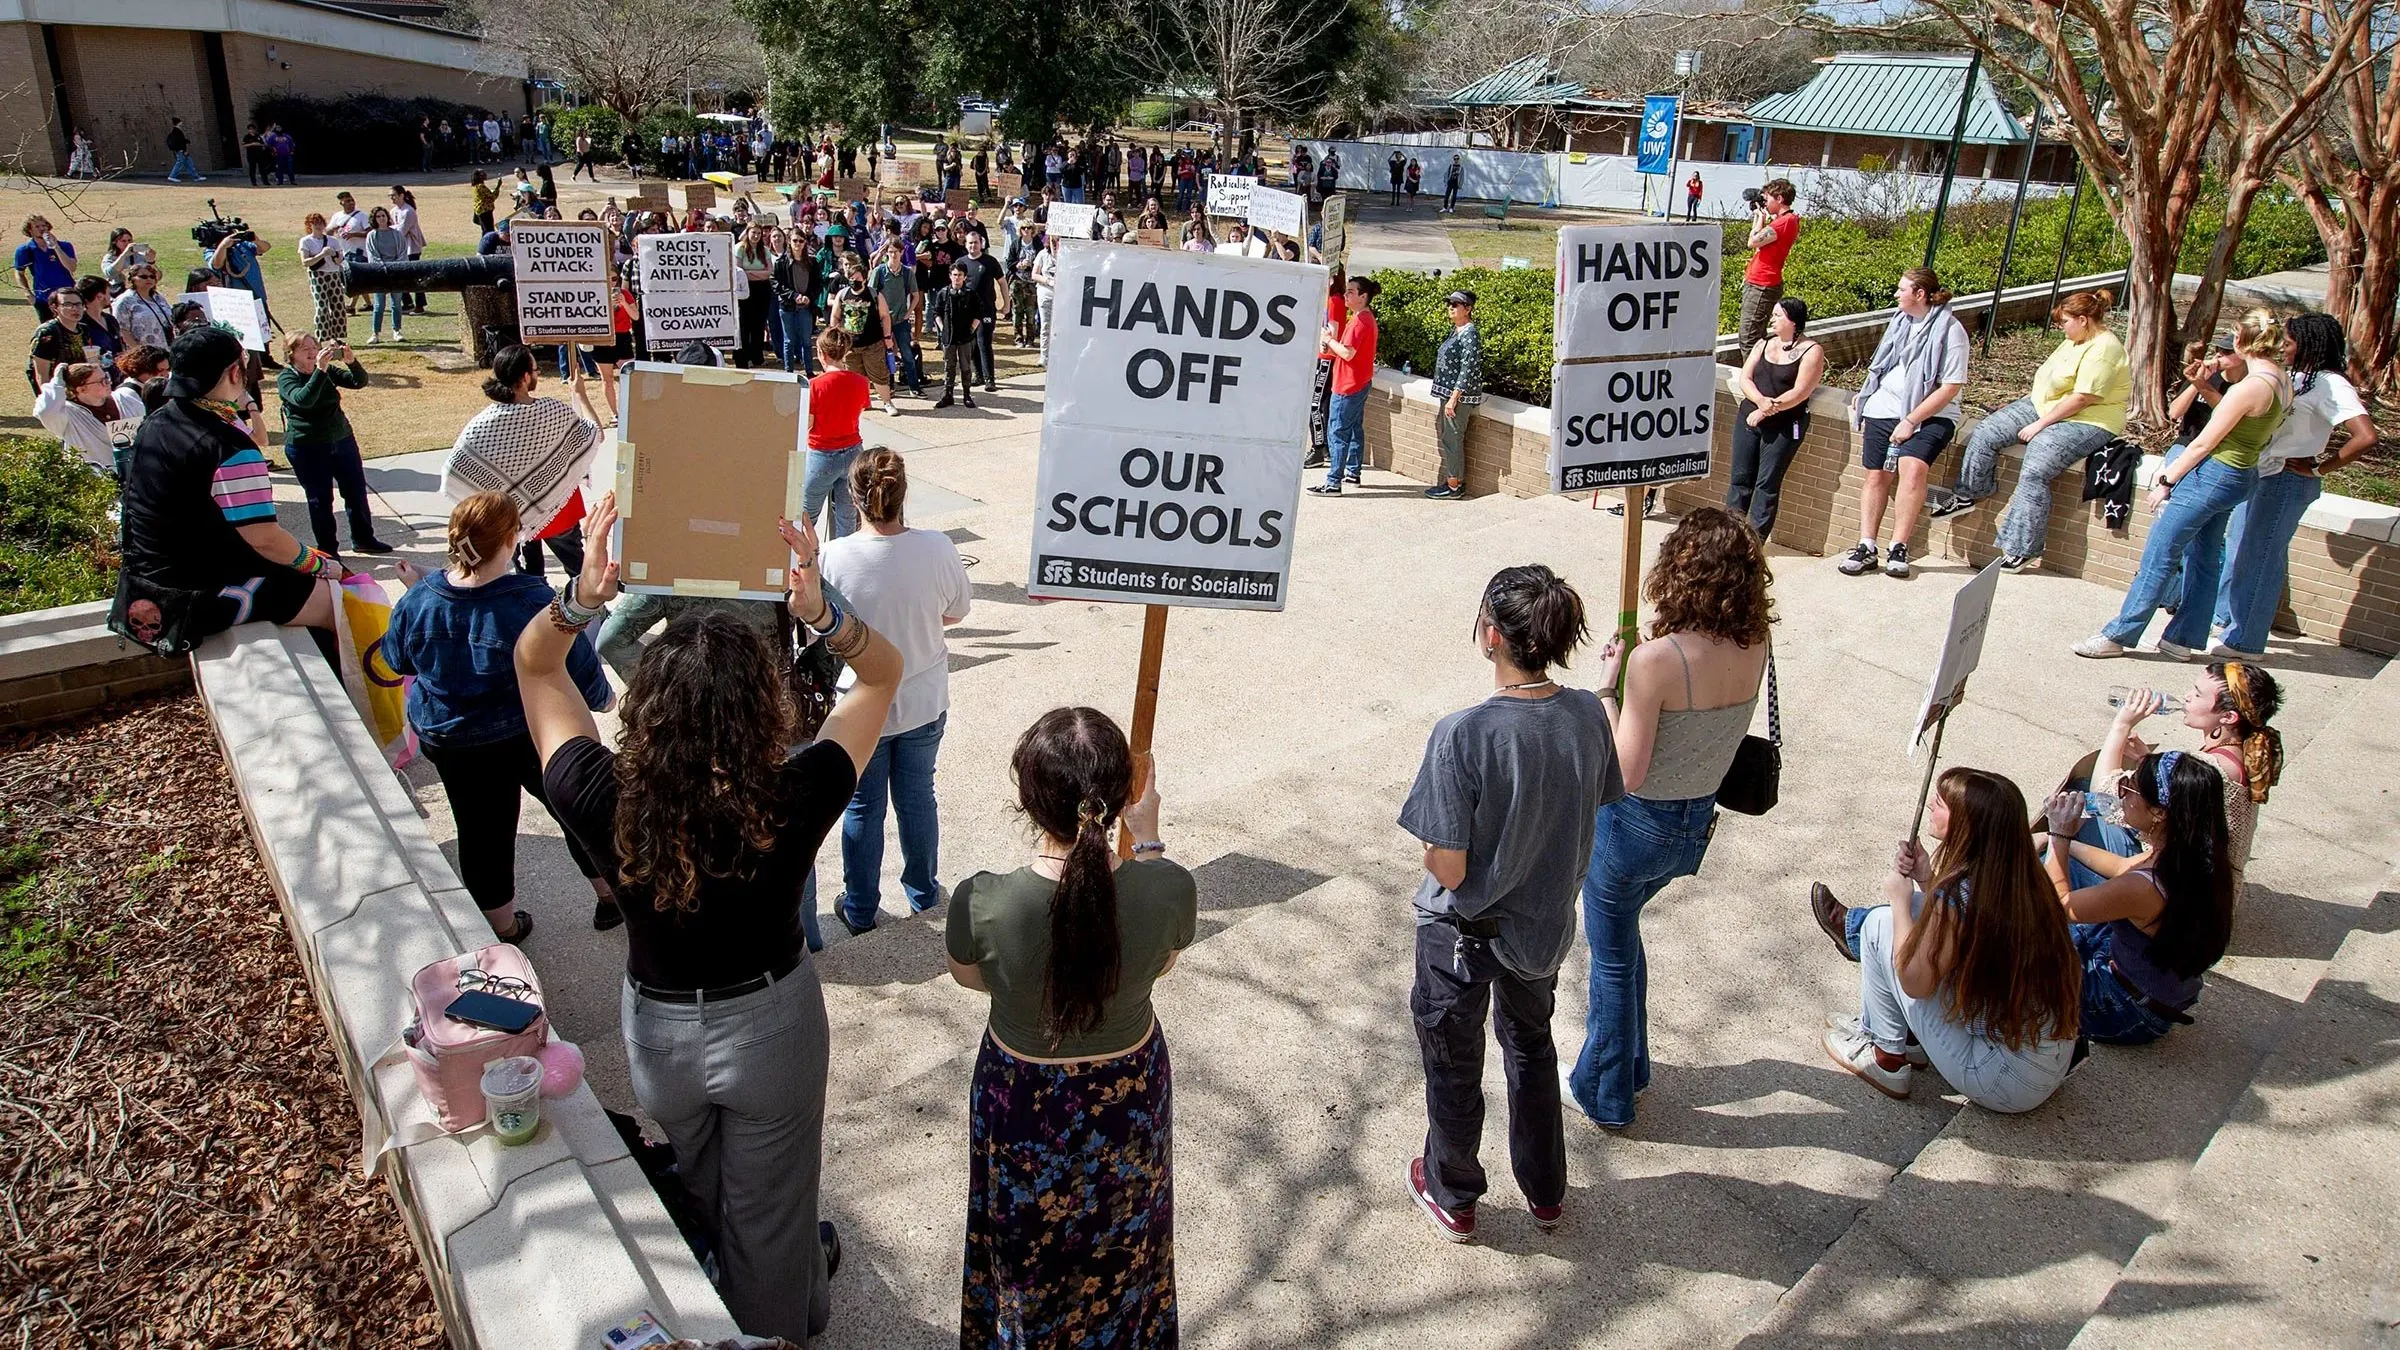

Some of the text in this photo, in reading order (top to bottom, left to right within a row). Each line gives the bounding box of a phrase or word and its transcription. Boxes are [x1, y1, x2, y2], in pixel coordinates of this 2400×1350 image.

[1643, 141, 1667, 156] UWF
[1219, 188, 1251, 205] Support
[517, 232, 601, 244] EDUCATION
[528, 246, 594, 258] IS UNDER
[656, 240, 711, 254] RACIST,
[530, 261, 593, 272] ATTACK:
[658, 254, 710, 268] SEXIST,
[1577, 240, 1710, 283] HANDS
[650, 269, 720, 280] ANTI-GAY
[528, 291, 600, 305] STAND UP,
[522, 305, 608, 319] FIGHT BACK!
[646, 305, 732, 318] RON DESANTIS,
[1079, 276, 1298, 345] HANDS
[1607, 291, 1680, 332] OFF
[538, 327, 566, 335] Students
[577, 326, 609, 334] Socialism
[661, 318, 721, 330] GO AWAY
[1125, 348, 1242, 404] OFF
[1608, 369, 1674, 403] OUR
[1565, 404, 1710, 447] SCHOOLS
[1120, 447, 1225, 495] OUR
[1565, 458, 1708, 488] SFS Students for Socialism
[1046, 492, 1284, 549] SCHOOLS
[1043, 561, 1274, 597] SFS Students for Socialism
